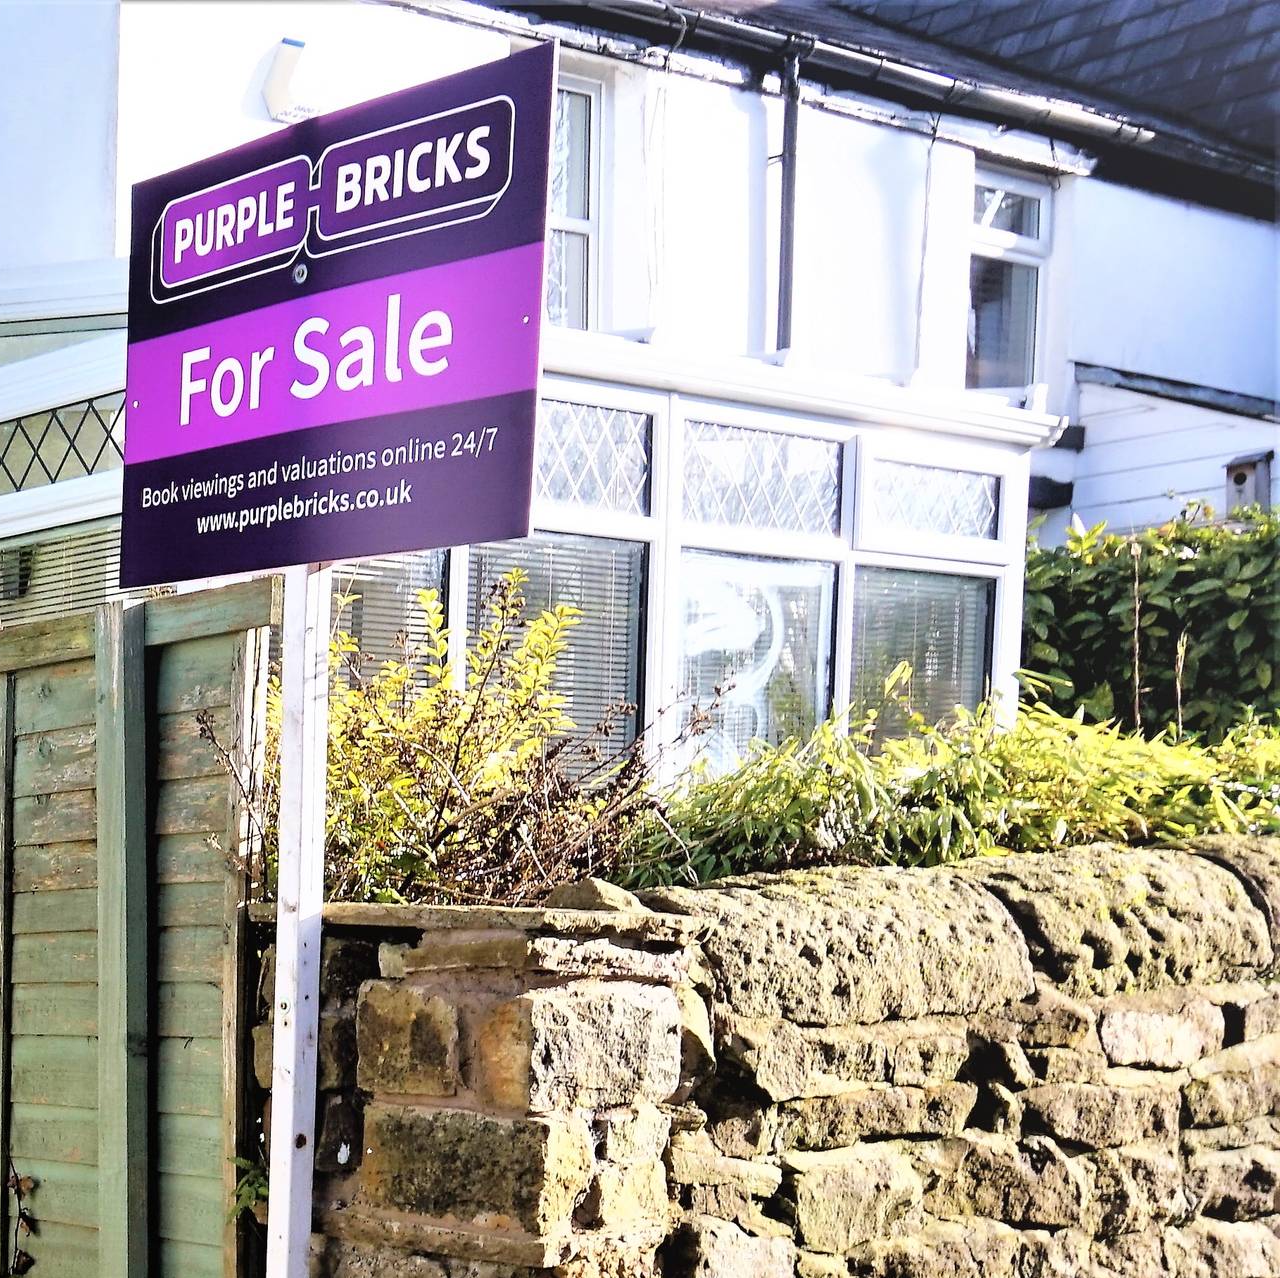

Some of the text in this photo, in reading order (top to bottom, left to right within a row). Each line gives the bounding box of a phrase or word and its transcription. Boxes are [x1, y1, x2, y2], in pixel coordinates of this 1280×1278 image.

[173, 124, 491, 265] PURPLE BRICKS
[180, 293, 454, 427] For Sale
[142, 425, 499, 509] Book viewings and valuations online 24/7
[195, 478, 413, 535] www.purplebricks.co.uk
